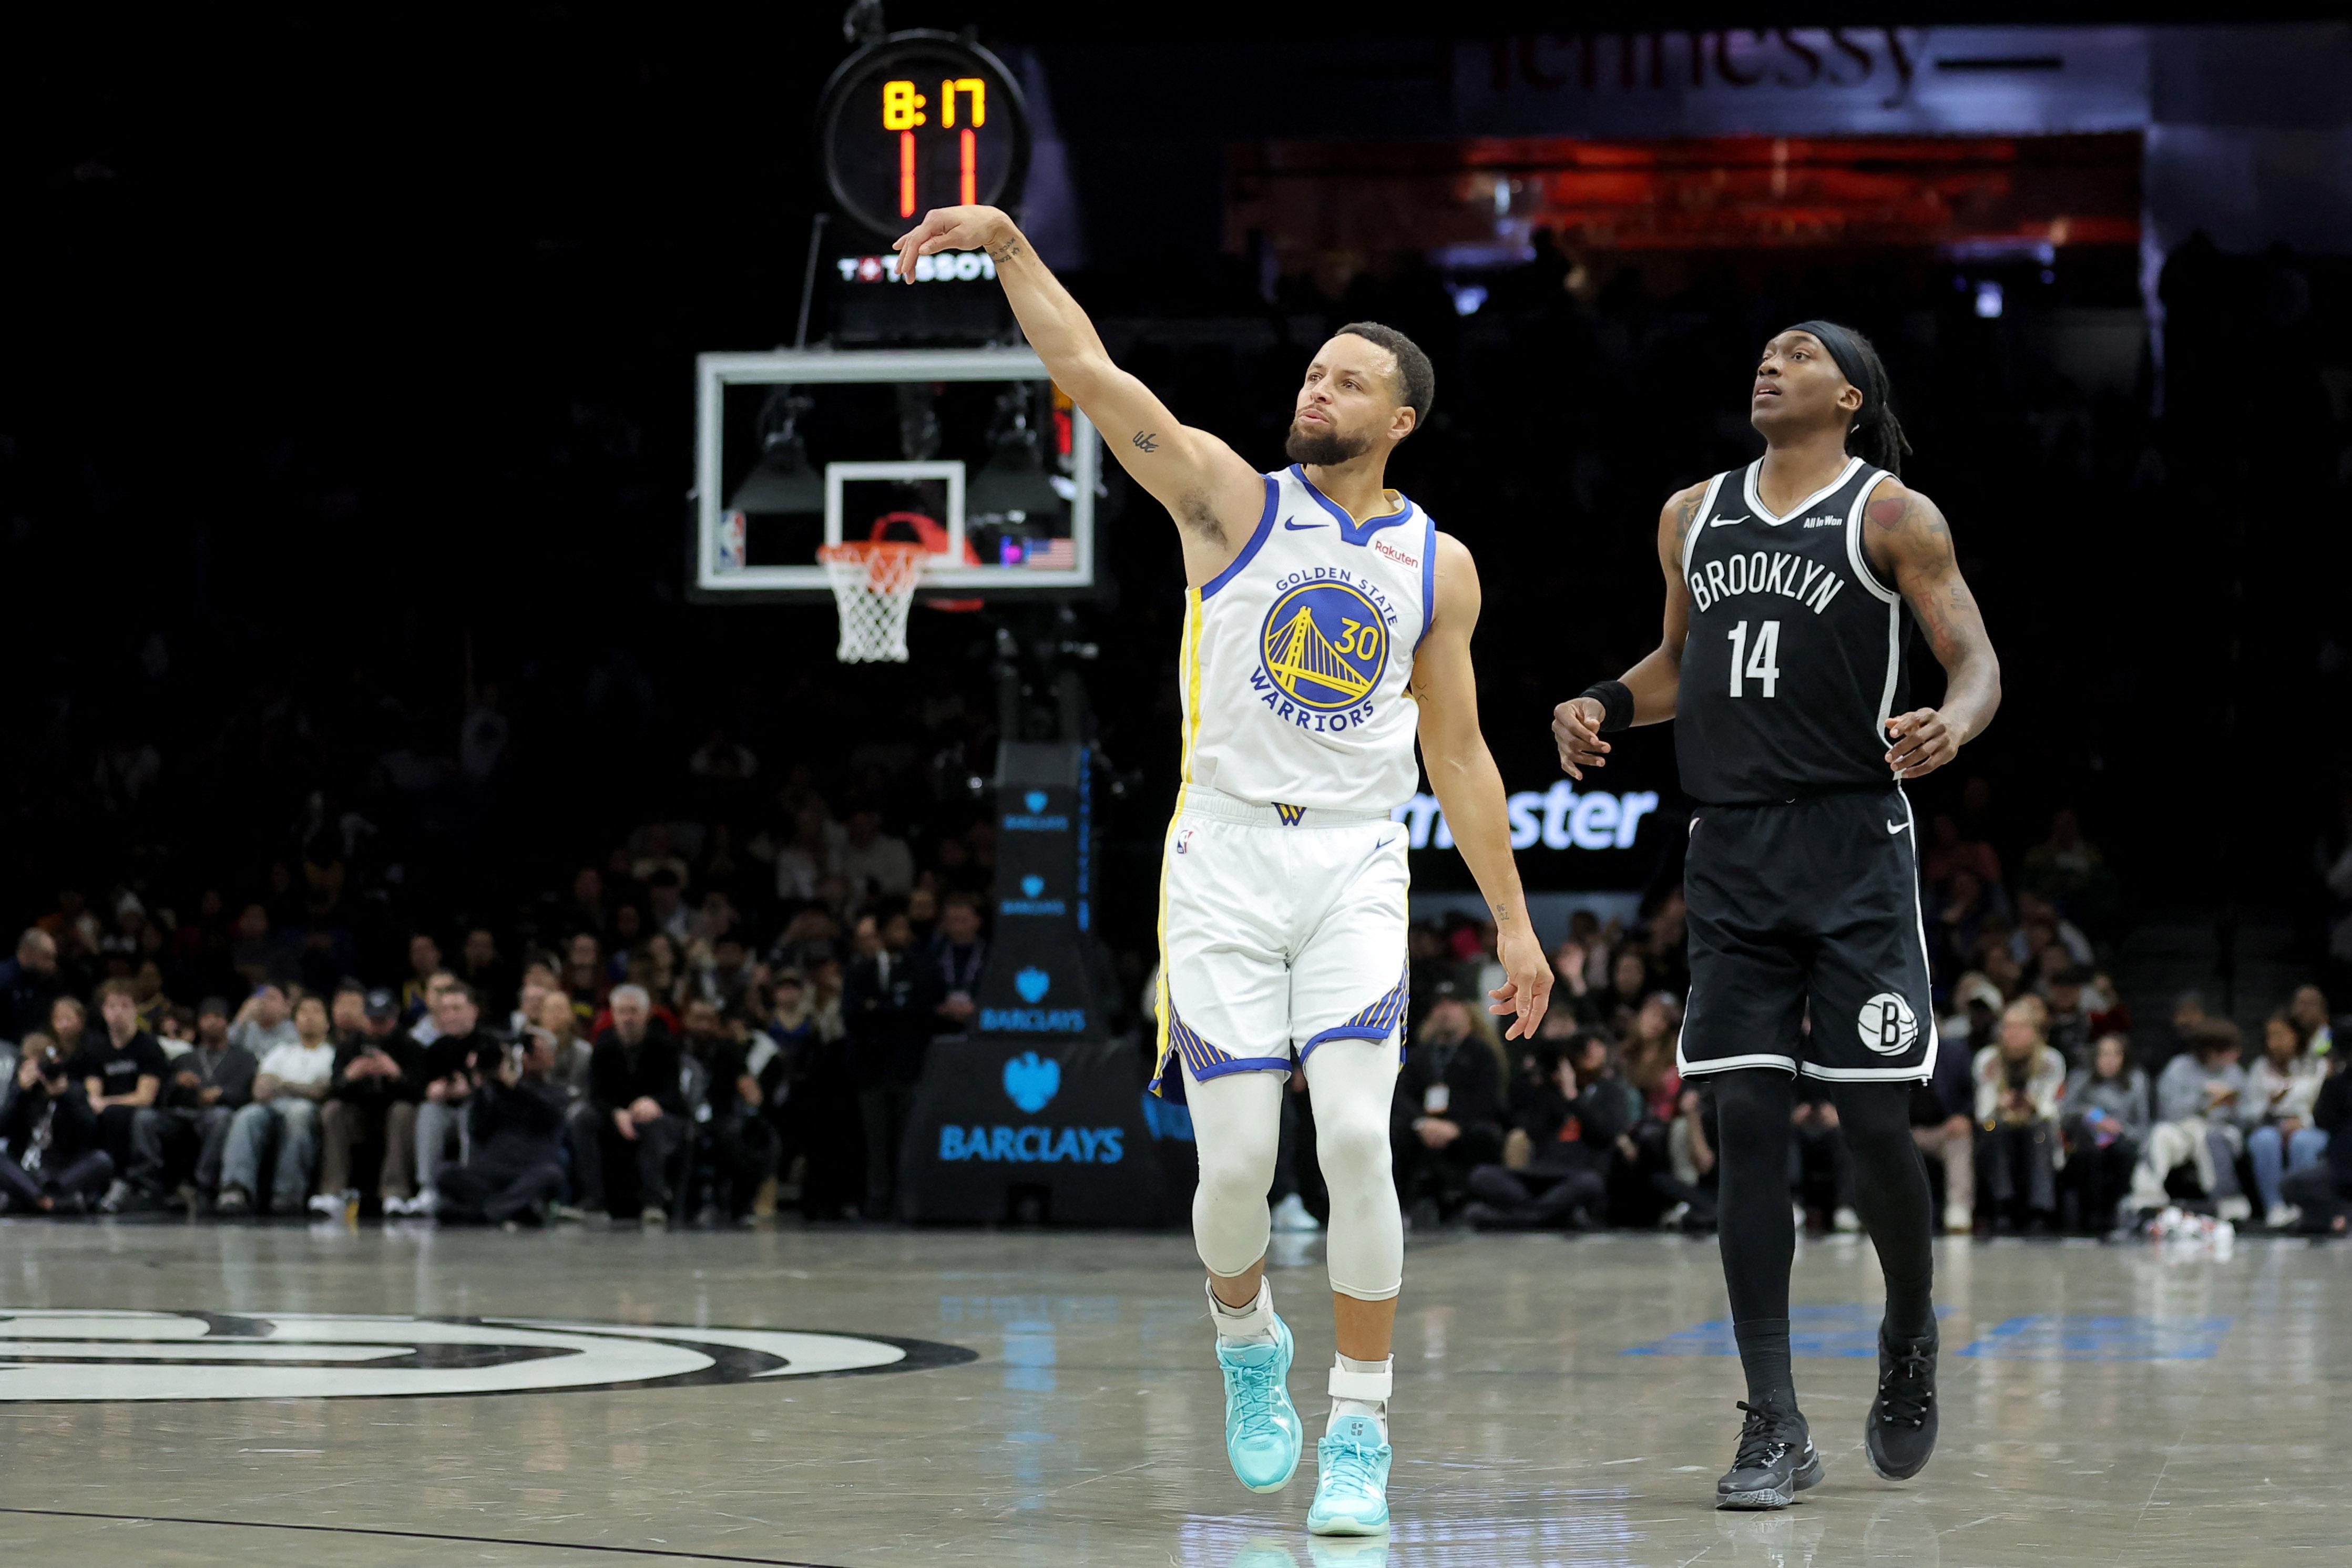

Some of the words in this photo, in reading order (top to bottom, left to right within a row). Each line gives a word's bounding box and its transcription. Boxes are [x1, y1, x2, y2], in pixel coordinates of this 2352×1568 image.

[883, 78, 986, 130] 8:17
[882, 252, 997, 283] TSSOT
[1803, 517, 1816, 528] All
[1816, 517, 1824, 527] In
[1824, 515, 1843, 526] Won
[1375, 540, 1418, 569] Rakuten
[1276, 567, 1351, 591] GOLDEN
[1359, 579, 1399, 626] STATE
[1690, 551, 1845, 615] BROOKLYN
[1334, 617, 1380, 661] 30
[1727, 620, 1781, 698] 14
[1250, 664, 1374, 732] WARRIORS
[1390, 780, 1660, 850] mster
[979, 1008, 1086, 1032] BARCLAYS
[939, 1124, 1124, 1164] BARCLAYS
